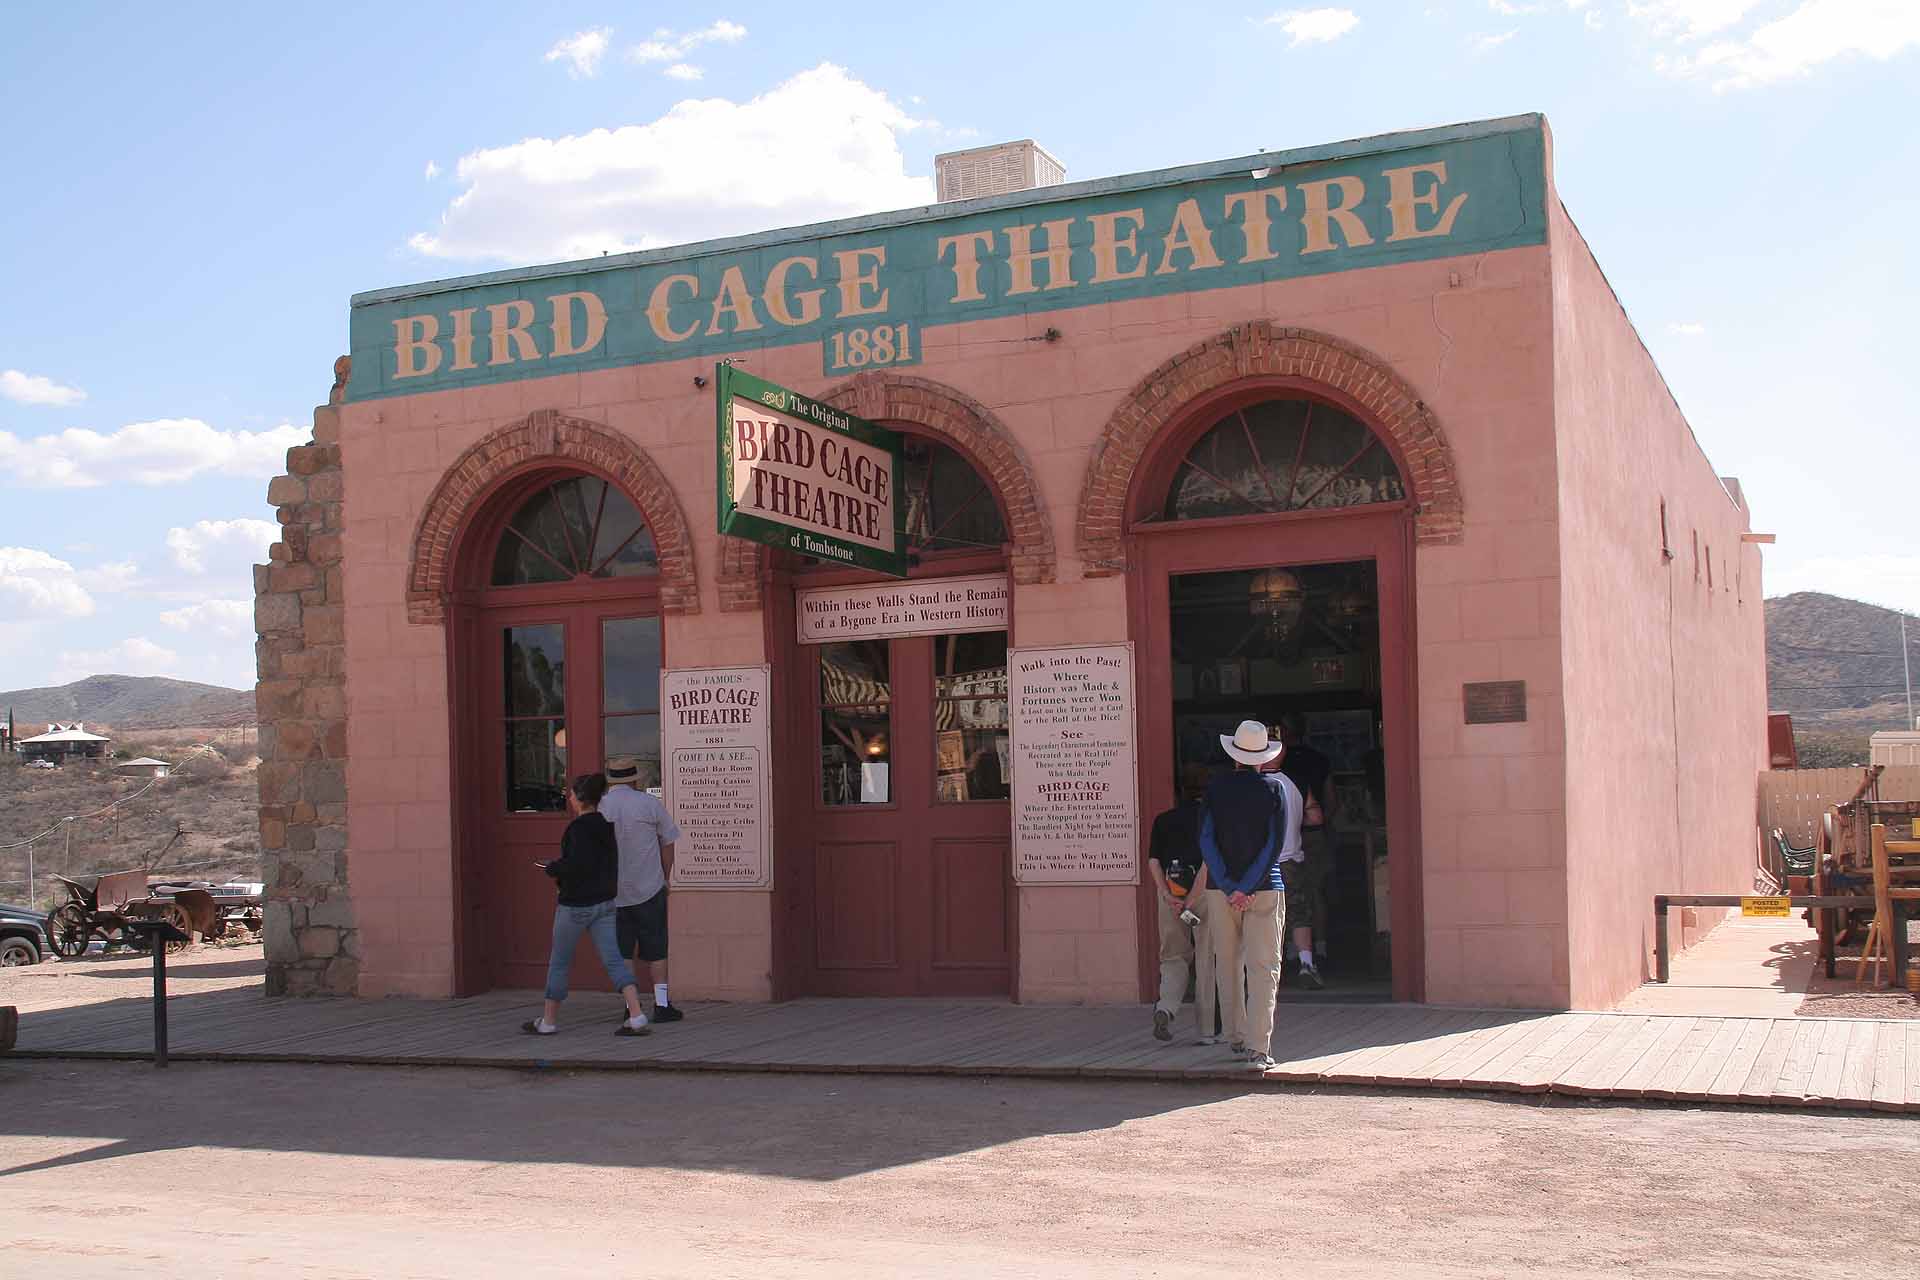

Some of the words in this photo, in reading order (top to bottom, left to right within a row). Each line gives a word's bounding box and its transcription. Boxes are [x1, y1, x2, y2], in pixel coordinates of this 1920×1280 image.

[392, 290, 609, 379] BIRD
[645, 245, 889, 344] CAGE
[938, 160, 1469, 305] THEATRE
[832, 322, 913, 369] 1881
[790, 395, 809, 416] The
[811, 404, 850, 431] Original
[736, 420, 815, 469] BIRD
[820, 439, 889, 506] CAGE
[751, 467, 880, 541] THEATRE
[791, 533, 801, 548] of
[804, 535, 854, 561] Tombstone
[806, 600, 840, 613] Within
[845, 599, 872, 611] these
[877, 595, 905, 608] Walls
[909, 592, 940, 606] Stand
[945, 589, 962, 603] the
[967, 587, 1008, 601] Remain
[815, 616, 824, 629] of
[830, 620, 835, 628] a
[841, 615, 877, 630] Bygone
[882, 612, 900, 625] Era
[905, 611, 915, 622] in
[920, 609, 961, 621] Western
[967, 606, 1005, 620] History
[1020, 660, 1045, 673] Walk
[1050, 658, 1071, 666] into
[1076, 656, 1091, 665] the
[1097, 656, 1121, 668] Past!
[705, 675, 742, 685] FAMOUS
[1053, 673, 1089, 682] Where
[1024, 685, 1056, 695] History
[1083, 682, 1107, 692] Made
[1112, 682, 1119, 690] &
[670, 689, 712, 710] BIRD
[716, 688, 760, 707] CAGE
[1022, 697, 1066, 706] Fortunes
[1099, 693, 1121, 702] Won
[678, 708, 752, 725] THEATRE
[1061, 731, 1083, 739] See
[1032, 743, 1060, 751] Legendary
[678, 752, 702, 762] COME
[706, 752, 716, 761] IN
[679, 766, 709, 774] Original
[1089, 760, 1111, 768] People
[682, 778, 720, 786] Gambling
[1038, 781, 1072, 793] BIRD
[1075, 781, 1110, 791] CAGE
[1046, 792, 1103, 802] THEATRE
[1048, 814, 1077, 822] Stopped
[1065, 823, 1083, 831] Night
[1082, 852, 1097, 861] Way
[1090, 862, 1133, 871] Happened!
